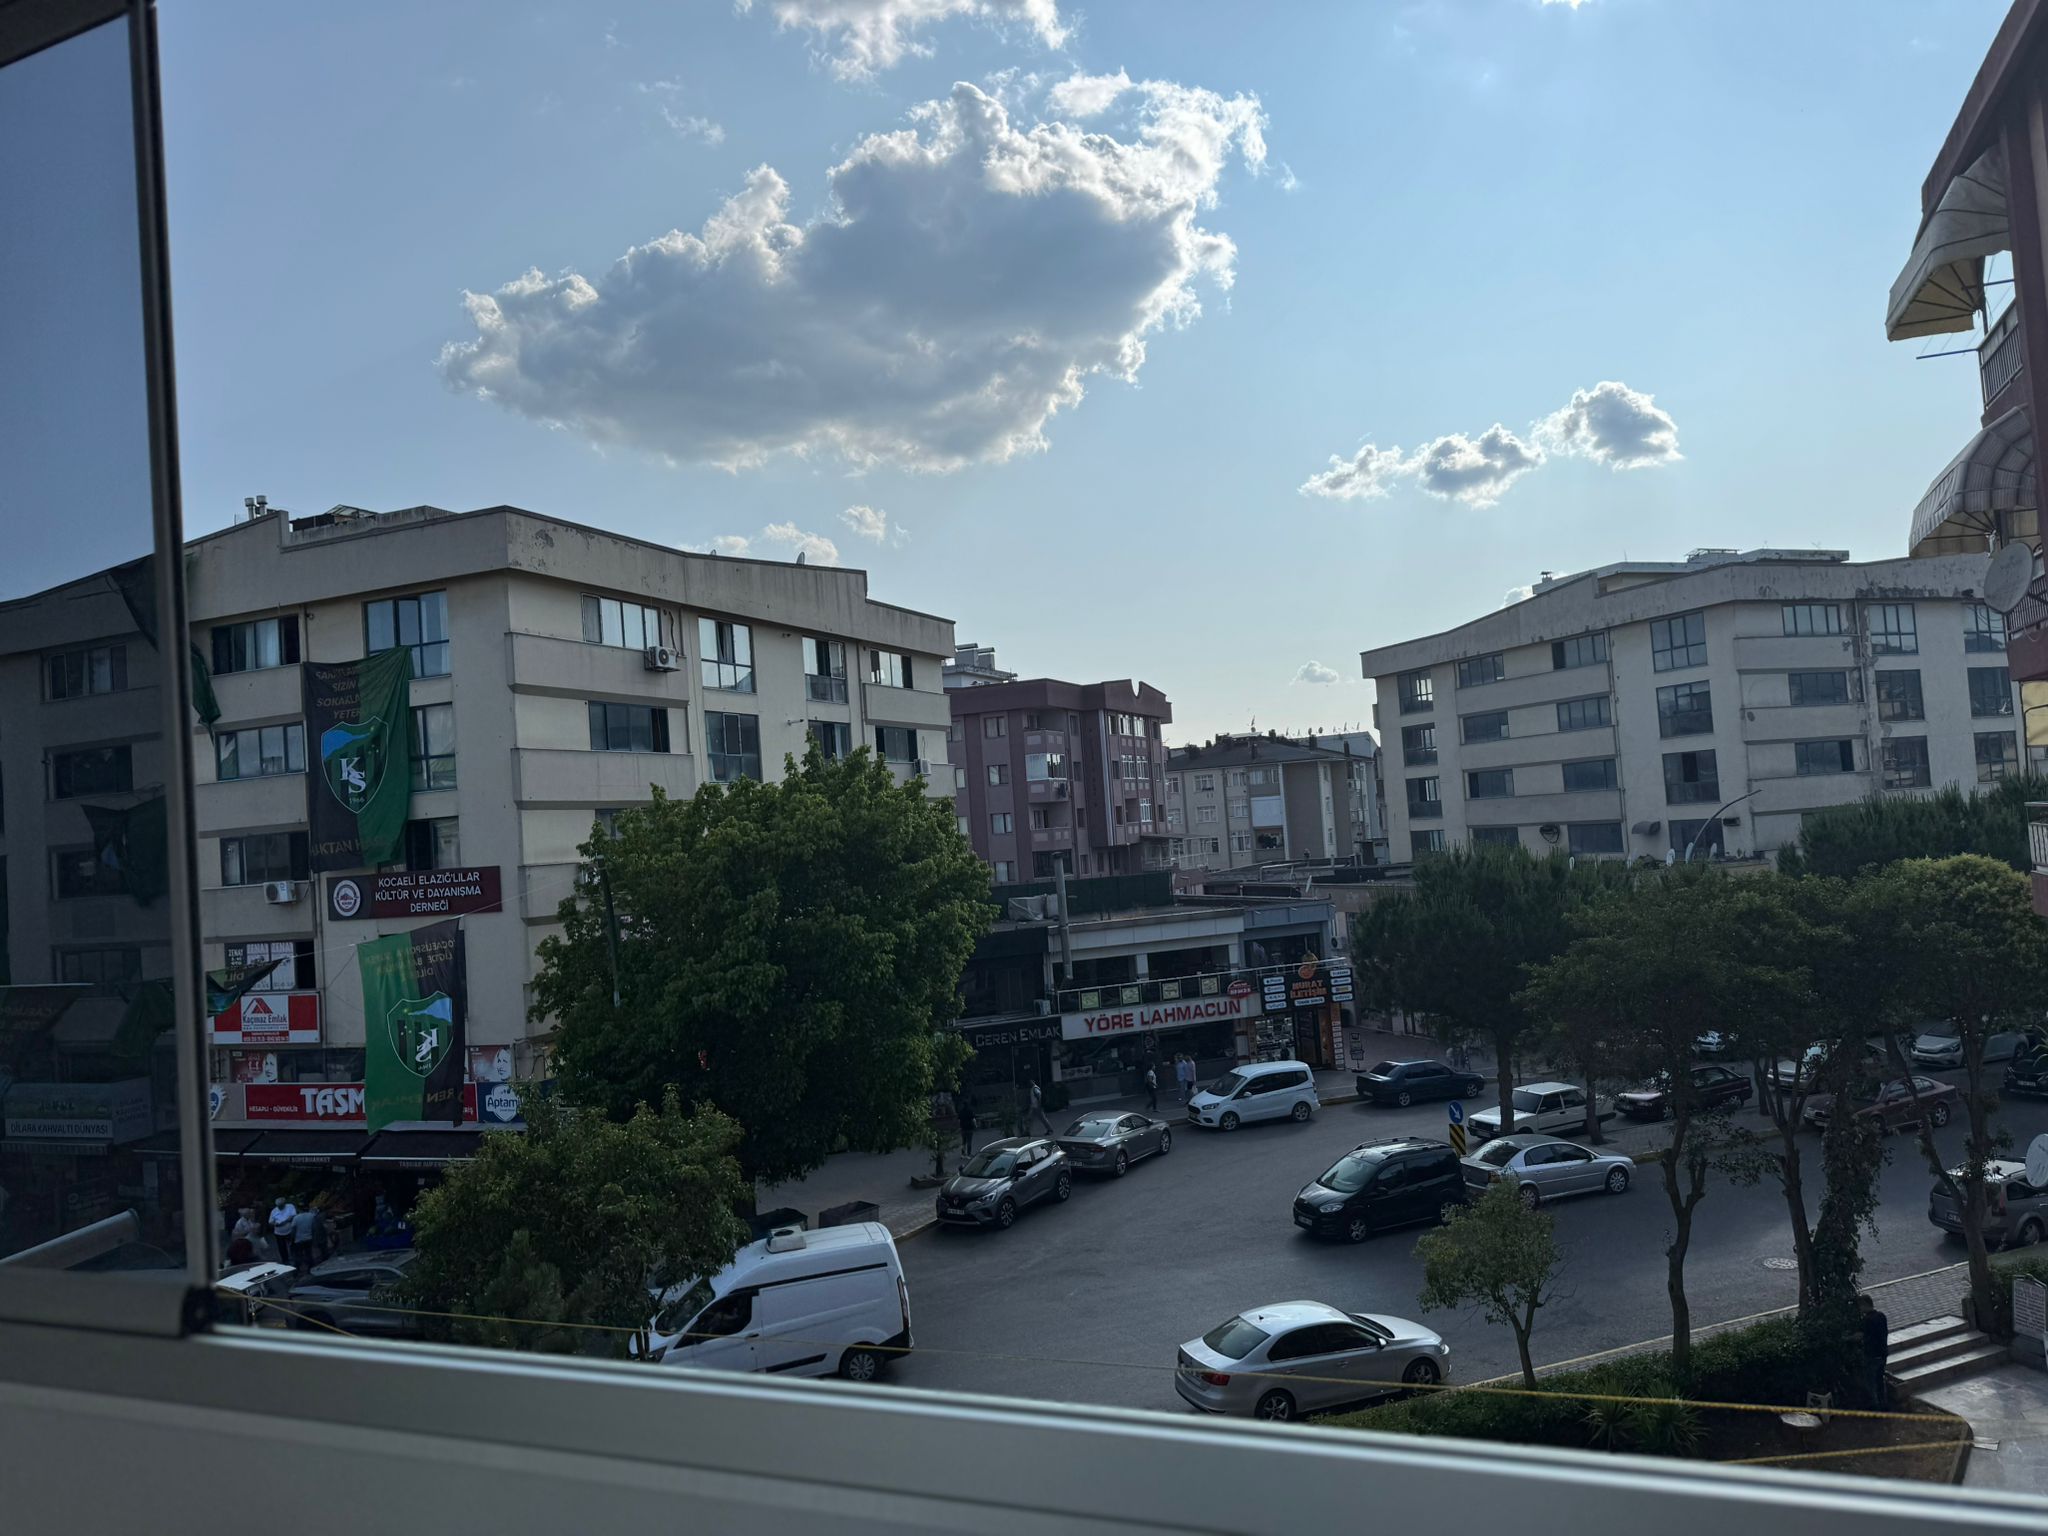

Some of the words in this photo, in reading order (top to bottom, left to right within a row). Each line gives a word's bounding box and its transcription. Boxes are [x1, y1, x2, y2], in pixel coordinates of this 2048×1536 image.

[378, 874, 416, 888] KOCAELİ
[418, 871, 480, 886] ELAZIĞ'LILAR
[375, 888, 410, 902] KÜLTÜR
[412, 888, 425, 899] VE
[427, 884, 482, 898] DAYANIŞMA
[410, 899, 449, 913] DERNEĞİ
[268, 1014, 288, 1023] Emlak
[1084, 1012, 1134, 1032] YÖRE
[1140, 1000, 1241, 1026] LAHMACUN
[1019, 1026, 1062, 1042] EMLAK
[11, 1122, 37, 1133] DİLARA
[37, 1123, 73, 1134] KAHVALTI
[74, 1123, 108, 1134] DÜNYASI
